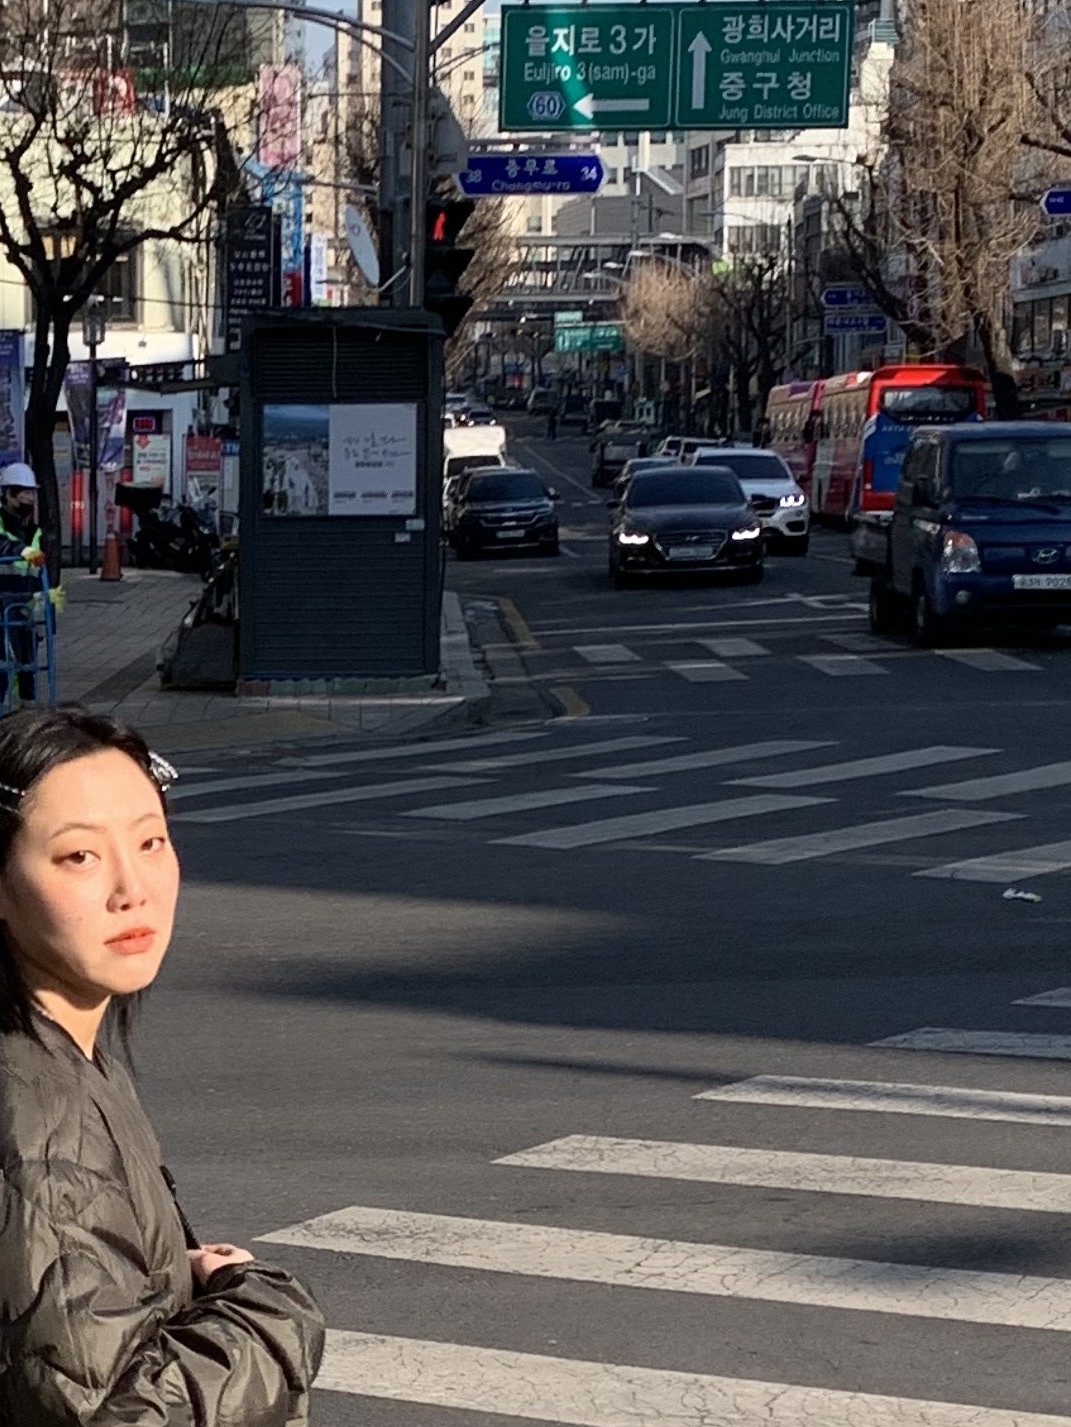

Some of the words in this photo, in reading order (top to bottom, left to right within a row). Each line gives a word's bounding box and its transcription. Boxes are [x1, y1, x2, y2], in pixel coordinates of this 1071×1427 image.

[722, 14, 841, 44] 광희사거리
[720, 48, 780, 67] Gwanghui
[788, 49, 840, 63] Junction
[524, 62, 571, 84] Euljiro
[535, 96, 556, 114] 60
[718, 104, 749, 123] Jung
[754, 104, 798, 119] District
[803, 103, 840, 119] Office
